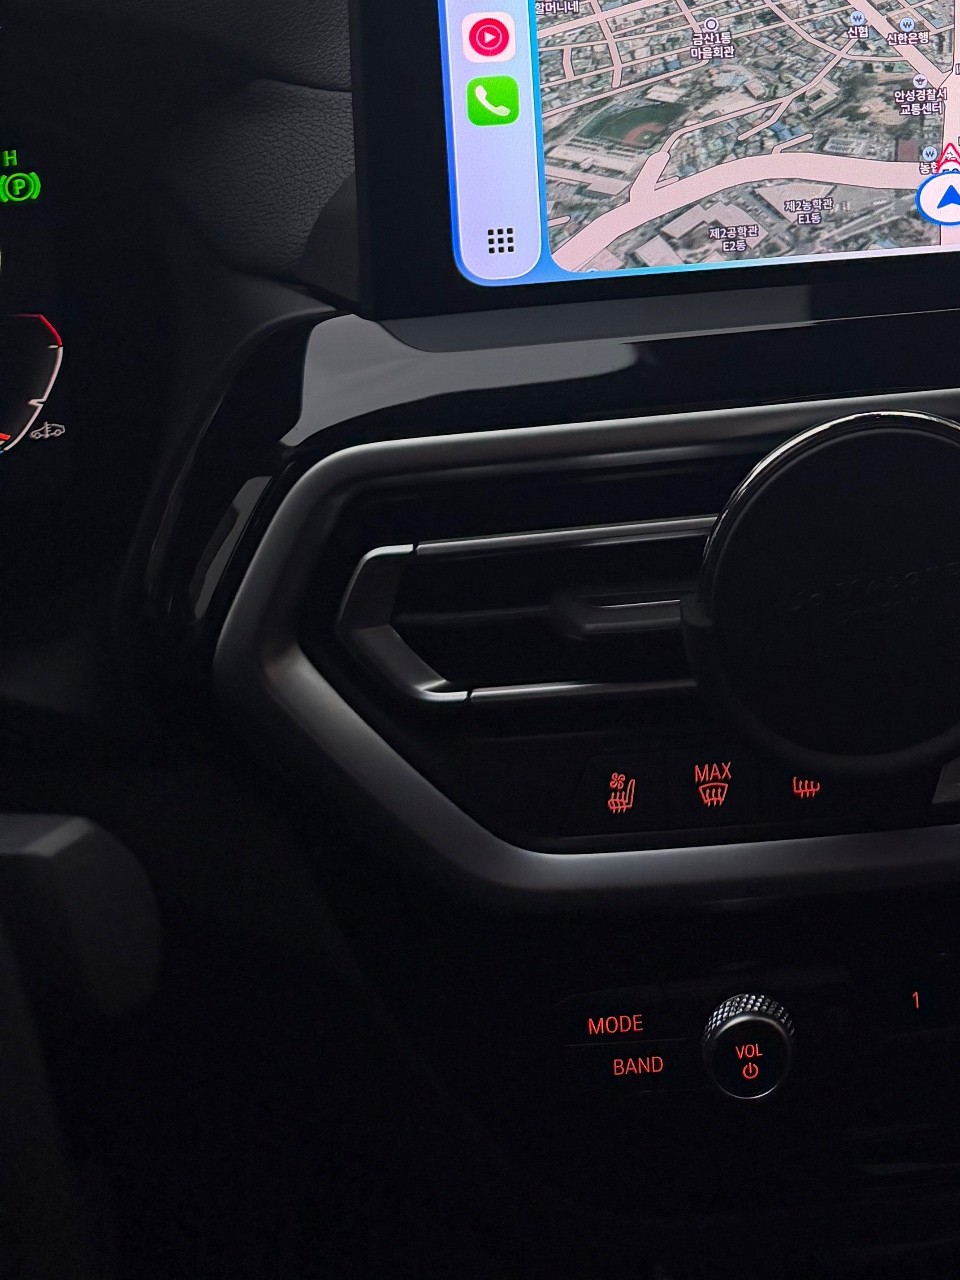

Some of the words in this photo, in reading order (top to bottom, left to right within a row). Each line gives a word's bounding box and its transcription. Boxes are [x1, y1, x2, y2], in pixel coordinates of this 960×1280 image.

[848, 26, 868, 38] 신협
[887, 32, 929, 45] 신한은행
[691, 46, 735, 59] 마을회관
[894, 88, 947, 103] 안성경찰서
[900, 103, 943, 115] 교통센터
[2, 150, 18, 166] H
[13, 179, 25, 195] P
[784, 198, 833, 212] 제2농학관
[798, 212, 821, 225] E1동
[709, 225, 759, 239] 제2공학관
[722, 240, 747, 252] E2동
[694, 761, 732, 783] MAX
[912, 991, 920, 1009] 1
[587, 1014, 644, 1035] MODE
[735, 1043, 763, 1059] VOL
[613, 1056, 664, 1076] BAND
